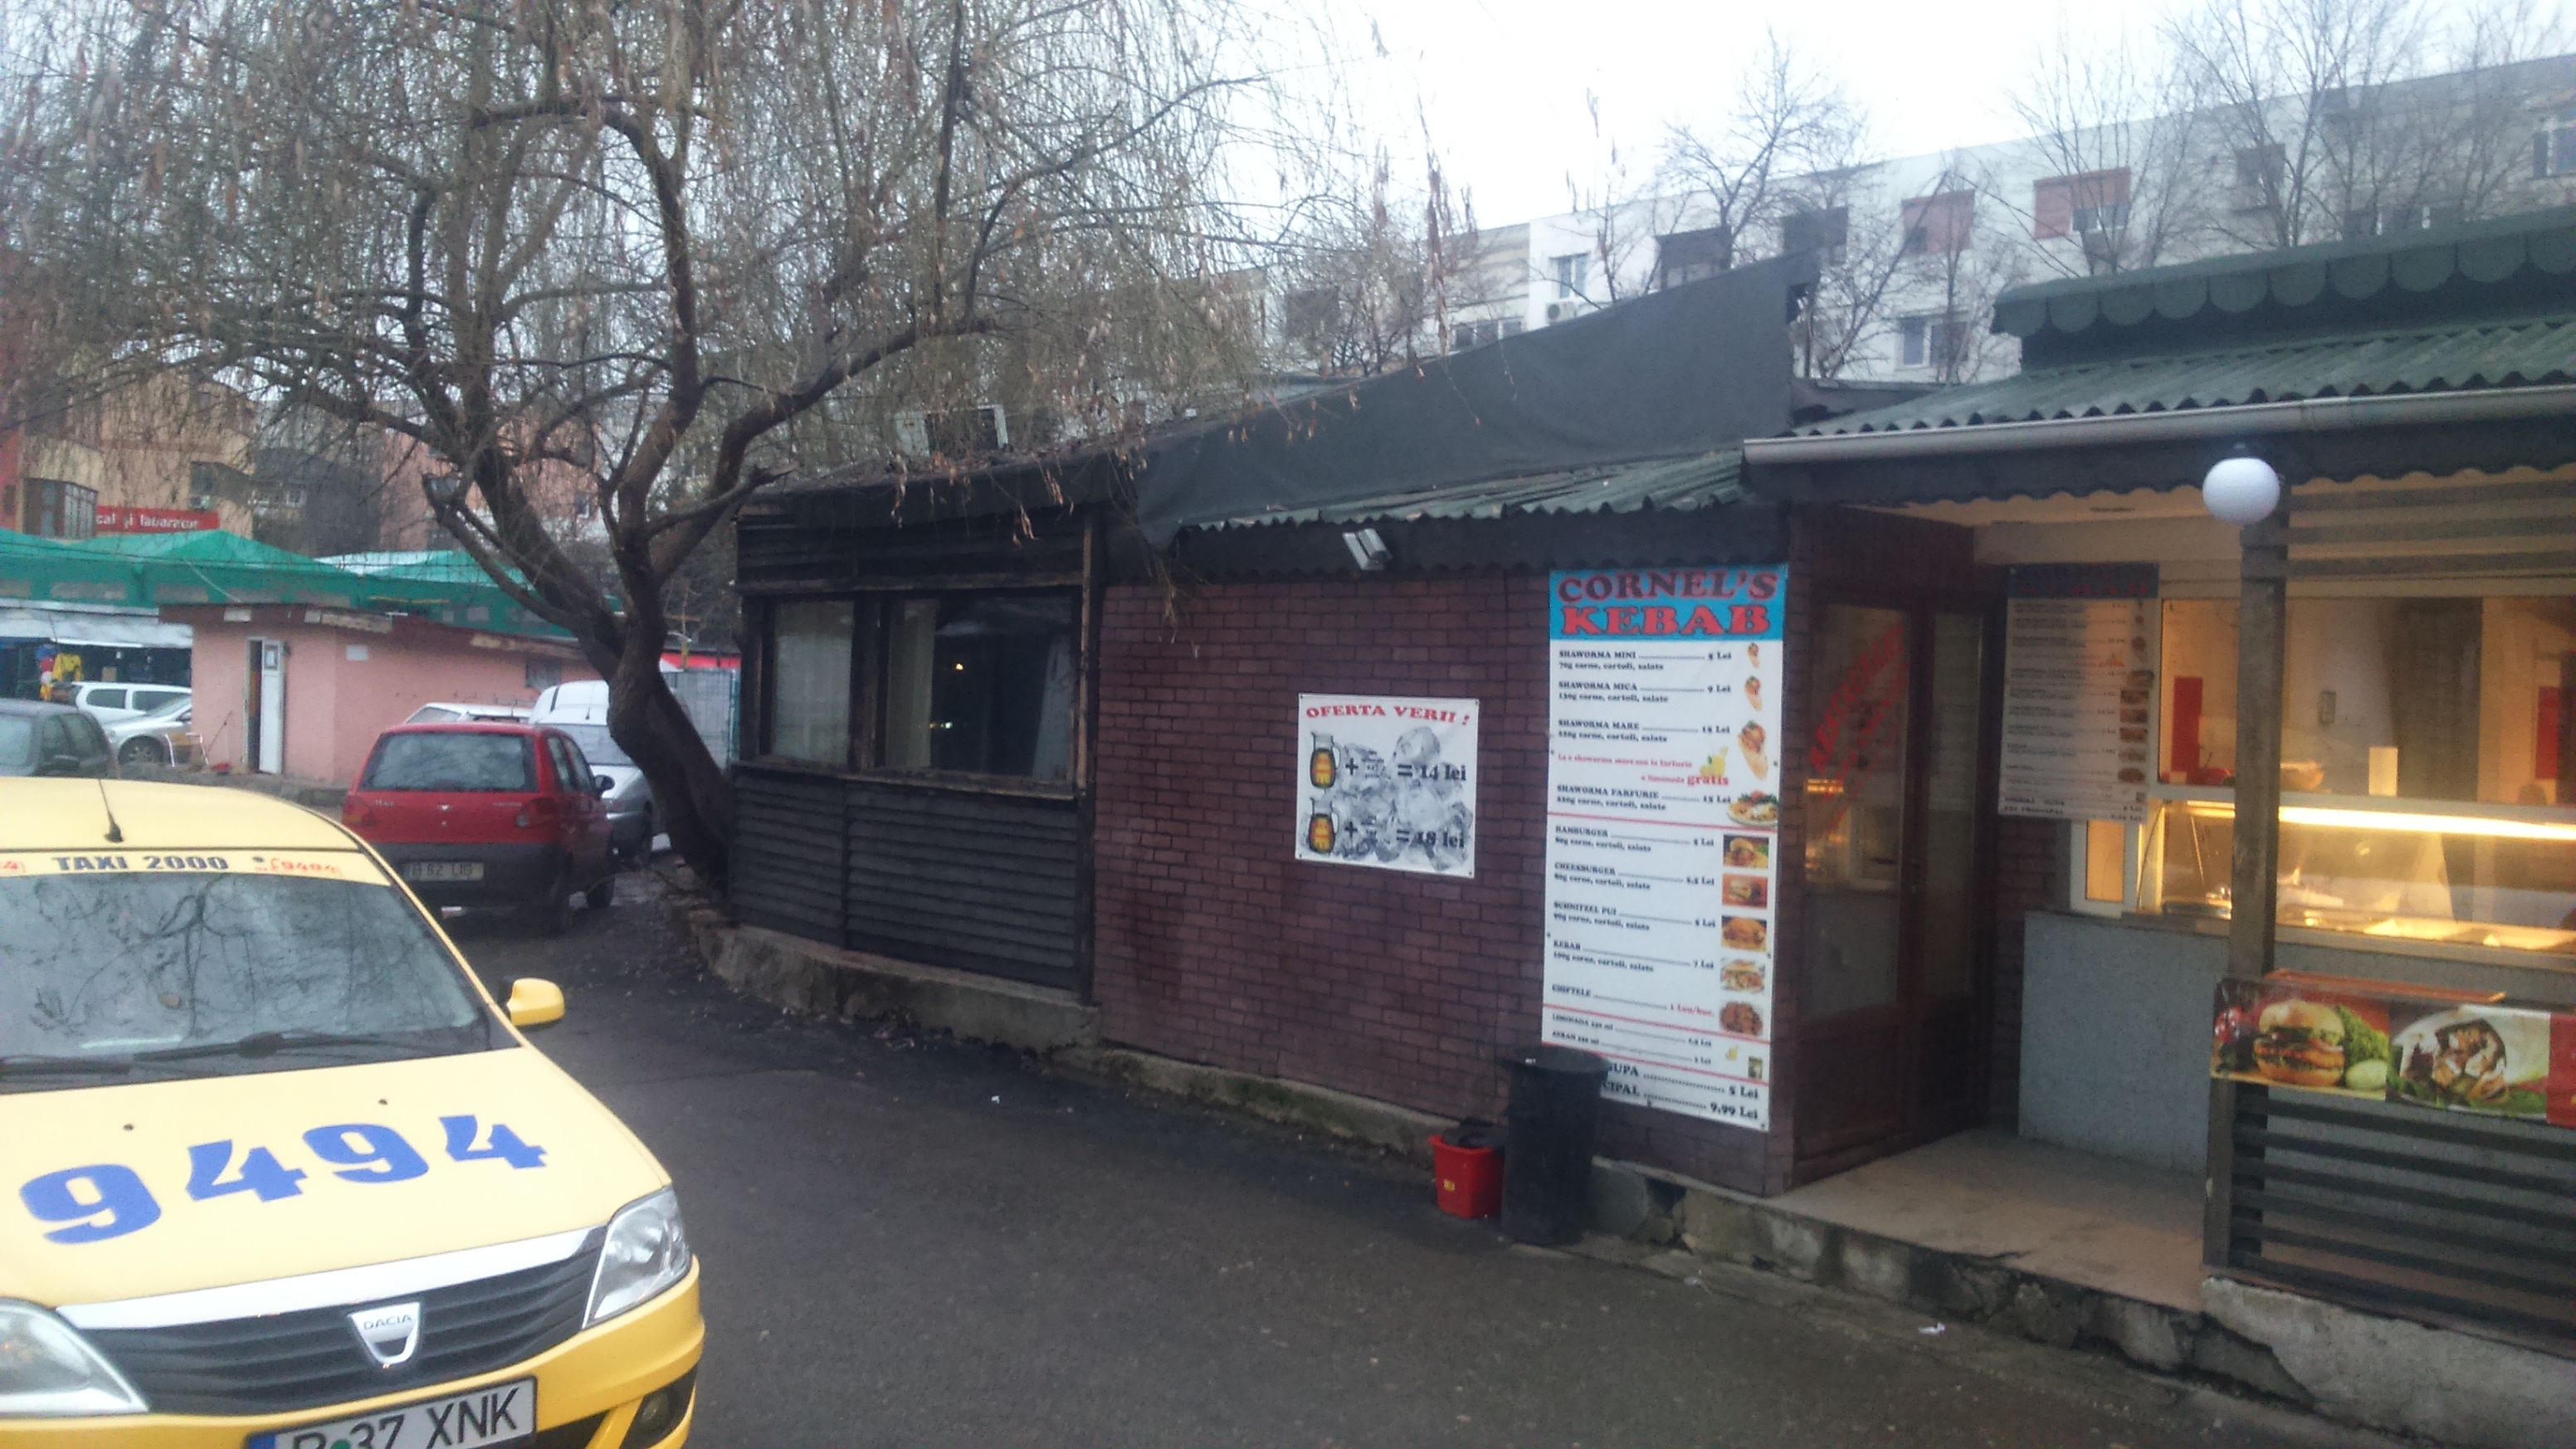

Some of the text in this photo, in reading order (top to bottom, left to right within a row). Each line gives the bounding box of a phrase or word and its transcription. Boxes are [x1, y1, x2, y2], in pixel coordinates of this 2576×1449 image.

[1557, 568, 1780, 603] CORNEL'S
[1561, 603, 1771, 636] KEBAB
[1559, 651, 1611, 659] SHAWORMA
[1614, 651, 1636, 659] MINI
[1559, 681, 1610, 690] SHAWORMA
[1305, 704, 1386, 718] OFERTA
[1394, 705, 1456, 723] VERII
[1559, 720, 1609, 729] SHAWORMA
[1612, 722, 1639, 730] MARE
[1420, 764, 1467, 781] 14 lei
[1686, 773, 1730, 786] gratis
[1557, 784, 1608, 796] SHAWORMA
[1612, 788, 1659, 799] FARFURIE
[1555, 825, 1608, 837] HAMBURGER
[1442, 832, 1465, 848] lei
[51, 856, 128, 871] TAXI
[143, 855, 229, 870] 2000
[1554, 900, 1599, 913] SCHNITZEL
[1554, 939, 1581, 951] KEBAB
[1602, 1081, 1759, 1120] CIPAL 9.99 Lei
[1740, 1085, 1759, 1100] Lei
[18, 1114, 549, 1246] 9494
[363, 1313, 413, 1331] DACIA
[424, 1387, 520, 1449] XNK
